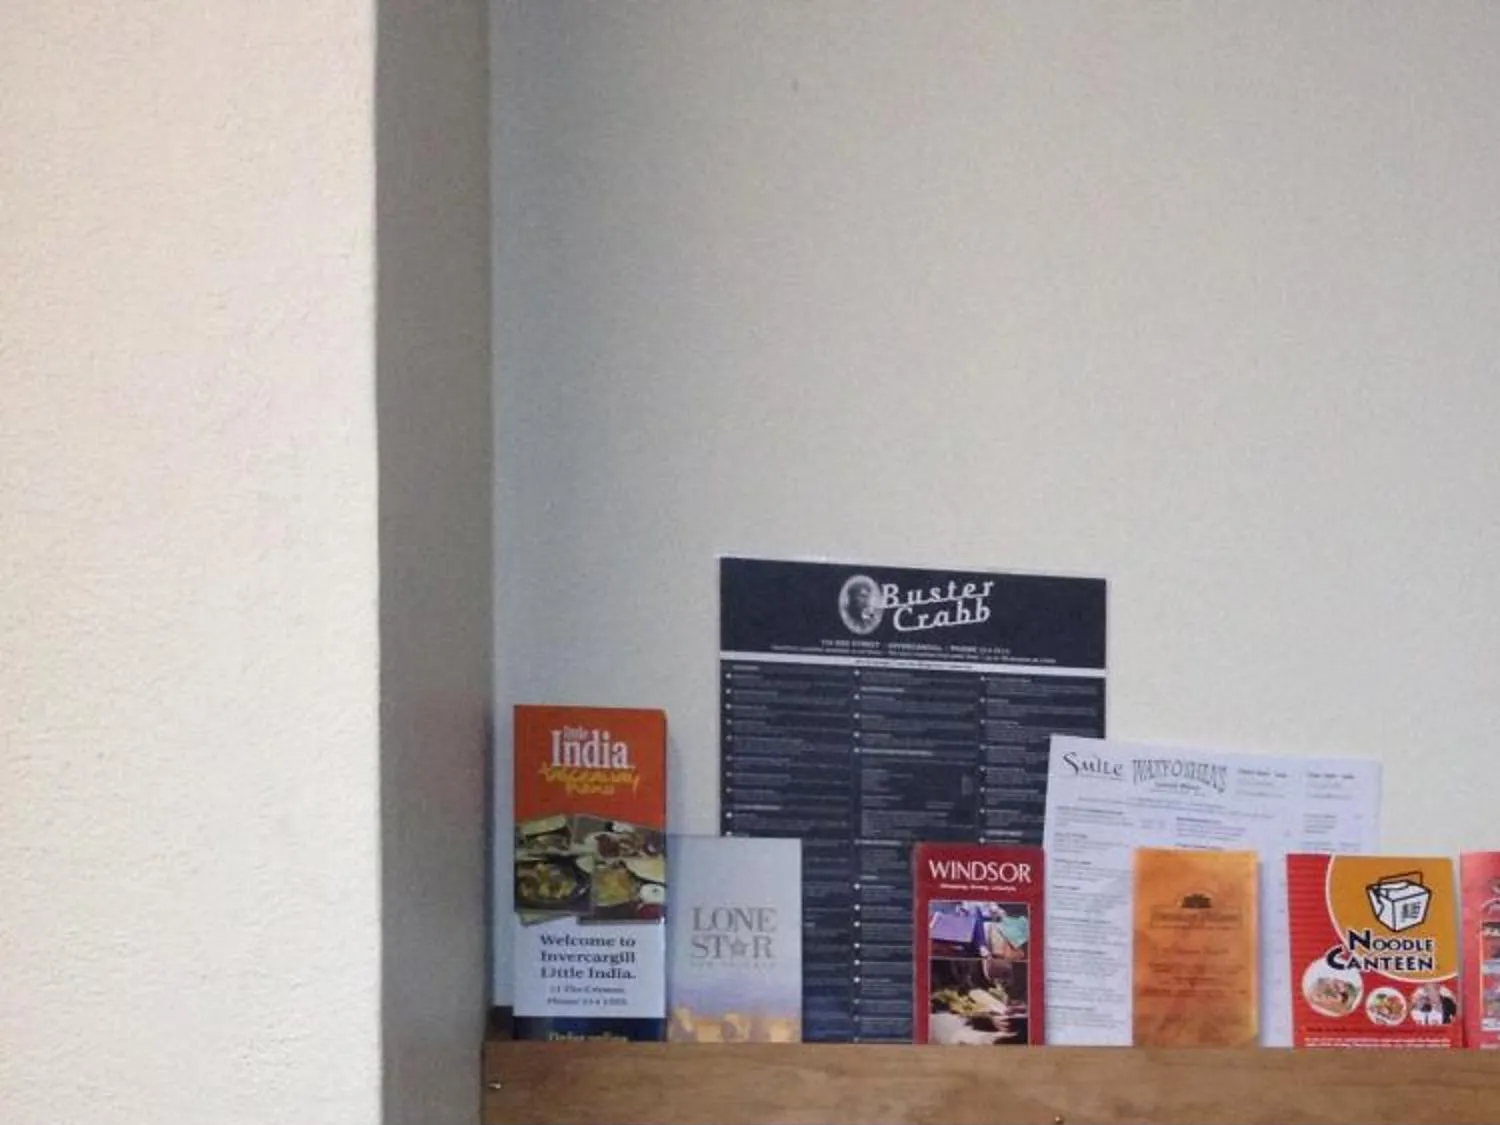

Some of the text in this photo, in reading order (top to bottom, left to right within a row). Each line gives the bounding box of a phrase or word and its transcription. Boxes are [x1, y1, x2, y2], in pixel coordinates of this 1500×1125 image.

[881, 579, 995, 608] Buster
[893, 598, 992, 632] Crabb
[551, 729, 629, 768] India
[928, 859, 1032, 883] WINDSOR
[693, 906, 778, 932] LONE
[540, 933, 636, 947] Welcome to
[540, 950, 636, 965] Invercargill
[1326, 948, 1433, 970] CANTEEN
[540, 966, 637, 979] Little India.
